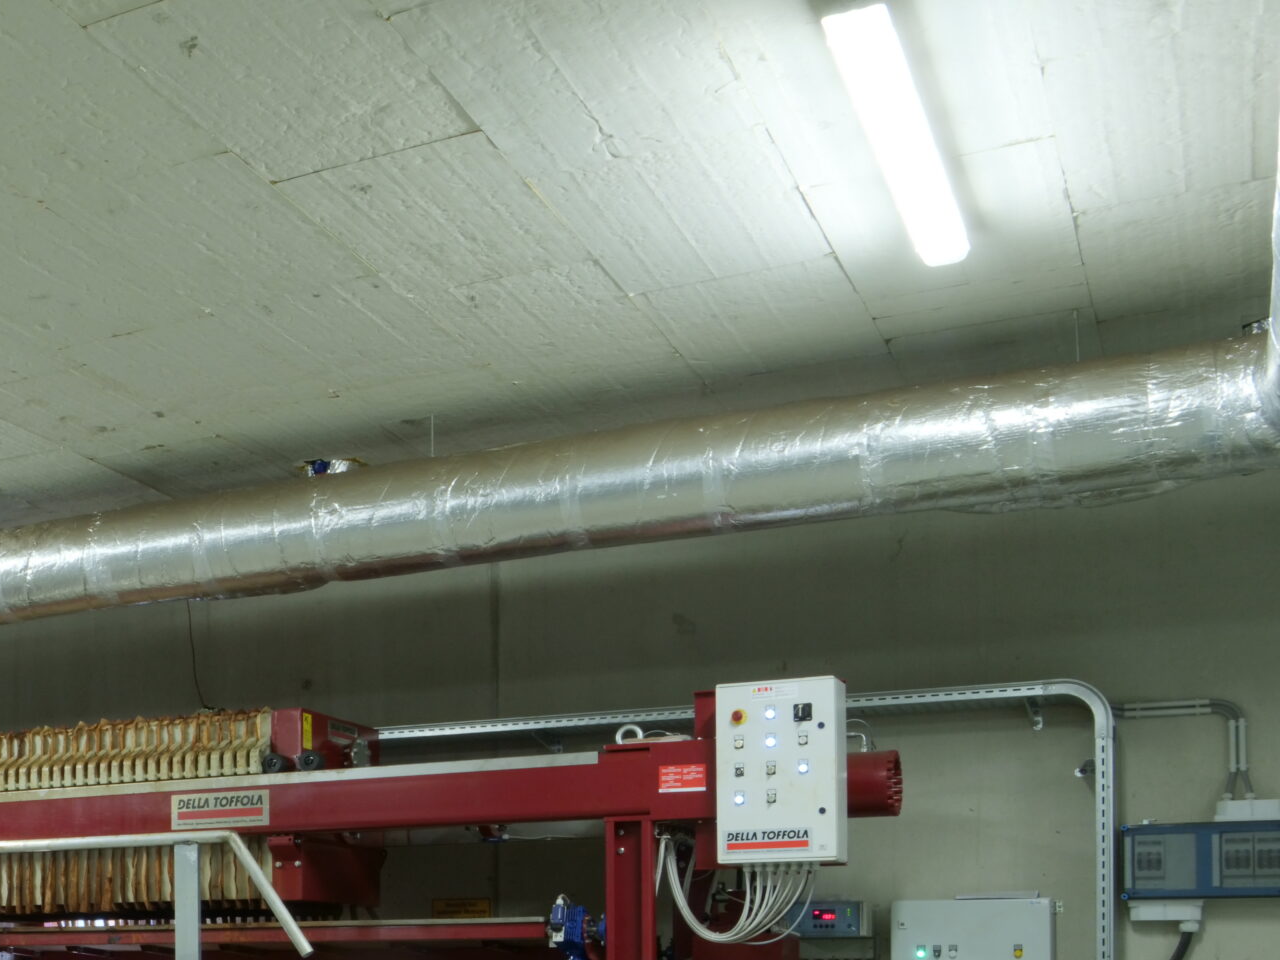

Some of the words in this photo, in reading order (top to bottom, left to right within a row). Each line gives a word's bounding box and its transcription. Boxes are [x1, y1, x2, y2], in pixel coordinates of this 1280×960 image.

[177, 797, 209, 810] DELLA
[213, 794, 263, 808] TOFFOLA
[726, 831, 758, 842] DELLA
[761, 829, 809, 841] TOFFOLA
